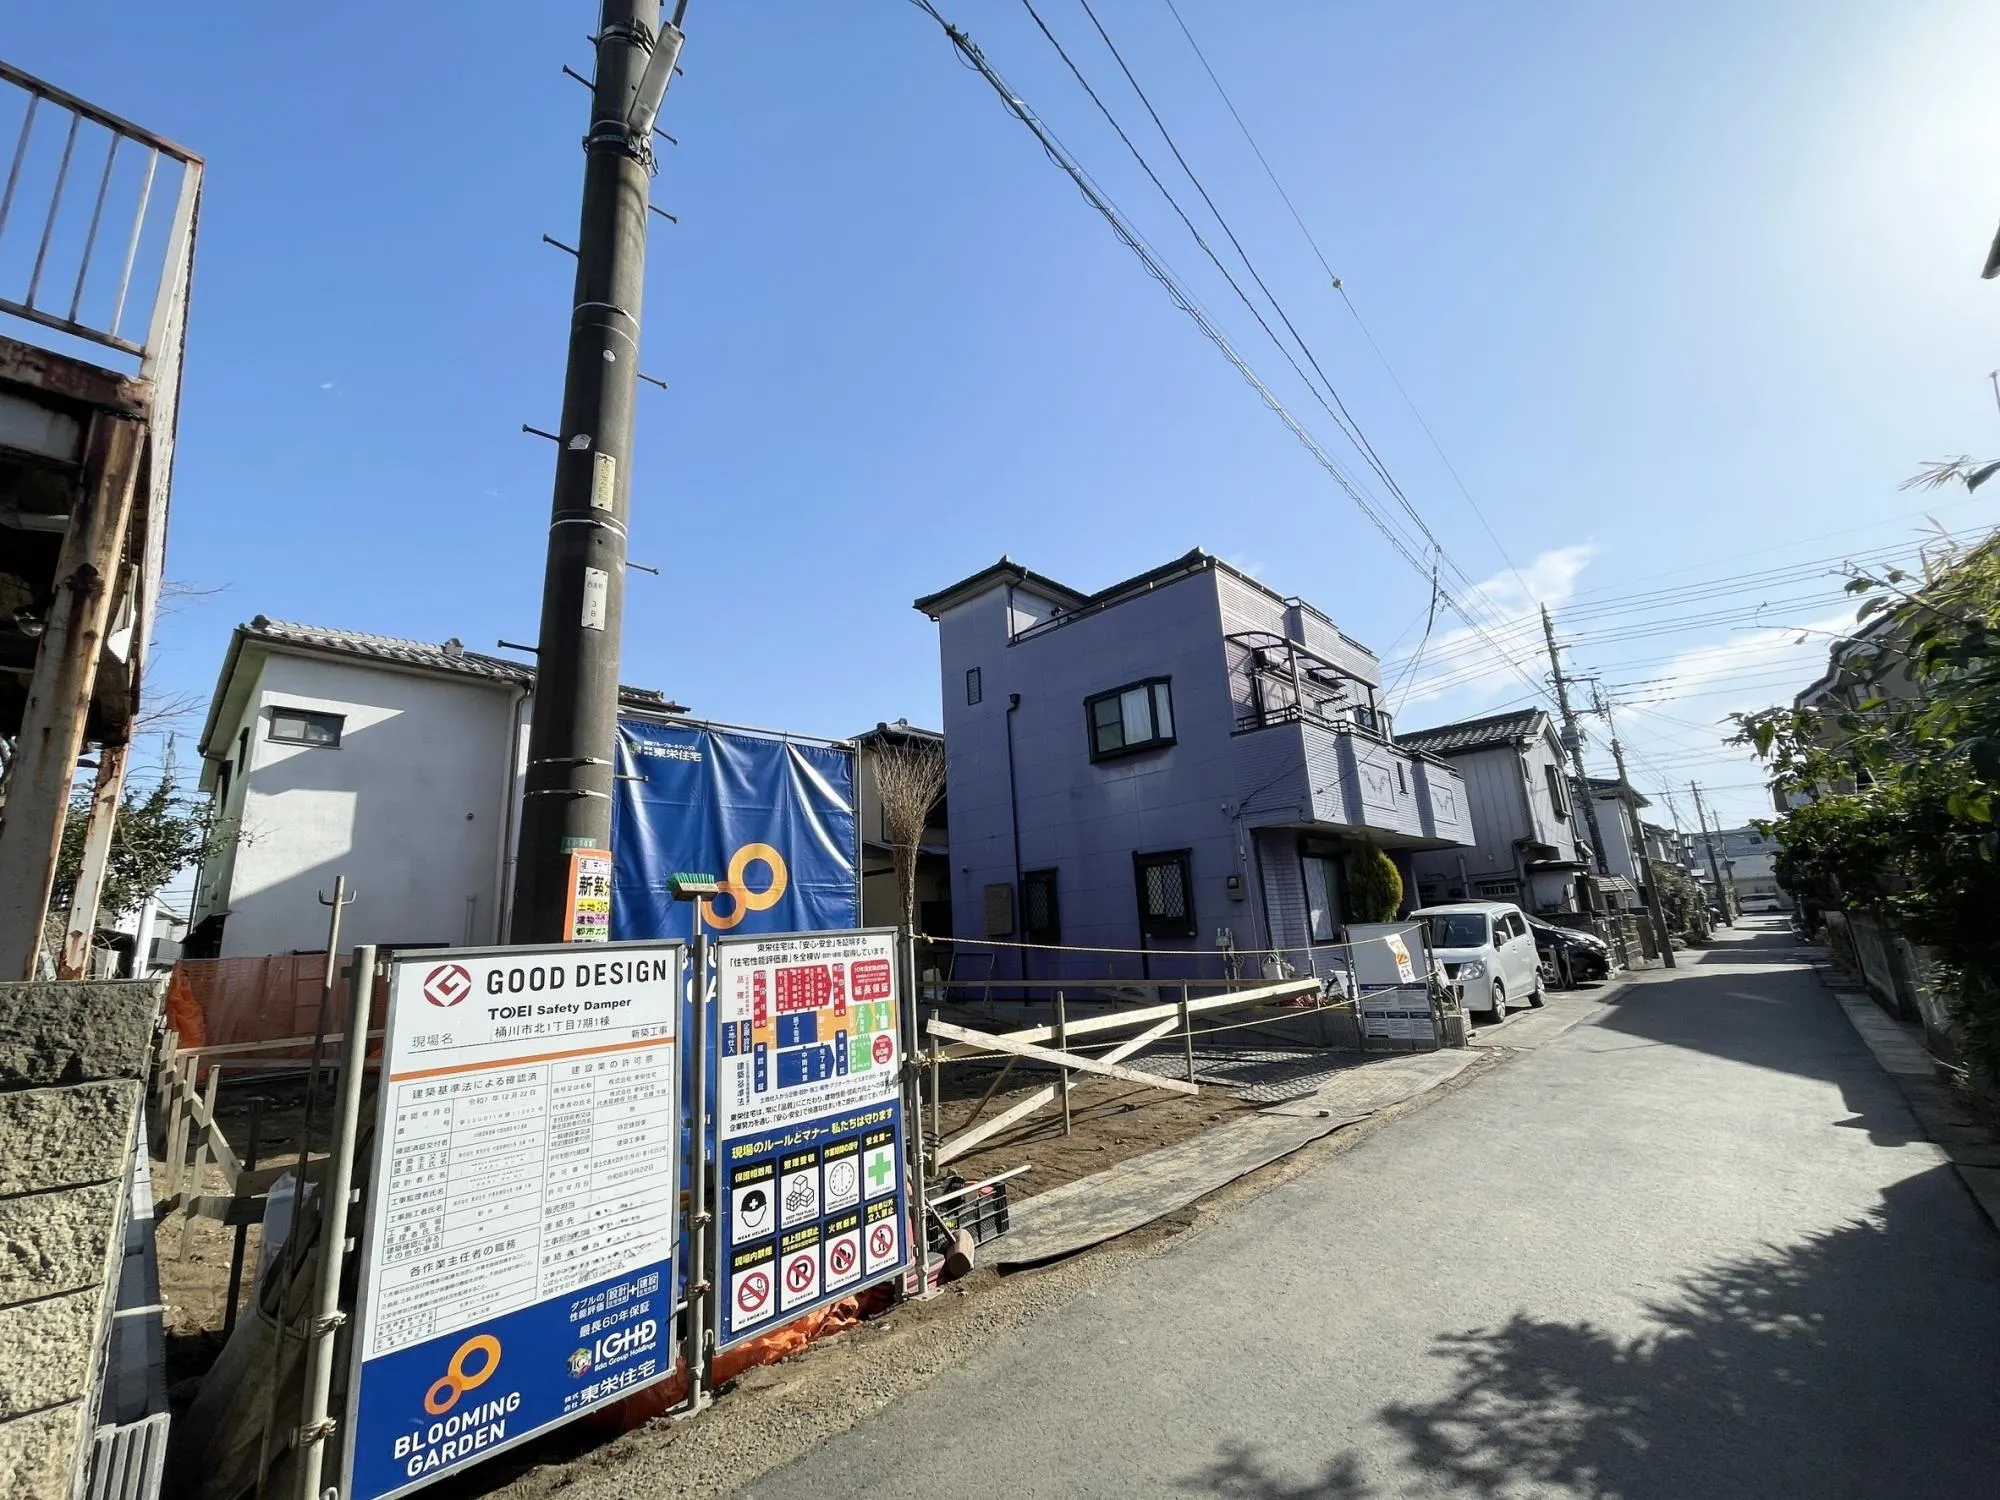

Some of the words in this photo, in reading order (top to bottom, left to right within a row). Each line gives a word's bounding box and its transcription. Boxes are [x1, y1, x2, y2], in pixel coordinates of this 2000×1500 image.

[653, 747, 702, 762] 東栄住宅
[487, 967, 565, 995] GOOD
[576, 960, 667, 987] DESIGN
[854, 983, 889, 996] 延長保証
[537, 1003, 580, 1016] Safety
[584, 998, 632, 1011] Damper
[494, 1016, 611, 1038] 桶川市北1丁目7期1棟
[631, 1026, 668, 1038] 新築工事
[411, 1034, 453, 1048] 現場名
[728, 1025, 736, 1054] 土地仕入
[412, 1072, 537, 1099] 建築基準法による確認済
[608, 1076, 632, 1085] 株式会社
[732, 1129, 830, 1160] 現場のルールとマナー
[831, 1107, 893, 1135] 私たちは守ります
[866, 1132, 892, 1146] 安全第一
[545, 1200, 576, 1215] 販売担当
[868, 1207, 895, 1223] 立入禁止
[737, 1232, 750, 1241] WEAR
[752, 1228, 770, 1237] HELMET
[386, 1243, 440, 1261] その他の事項
[410, 1239, 517, 1278] 各作業主任者の職務
[734, 1245, 773, 1268] 現場内禁煙
[639, 1275, 657, 1289] 建設
[833, 1277, 844, 1286] OPEN
[571, 1293, 605, 1312] ダブルの
[608, 1286, 629, 1301] 設計
[795, 1291, 814, 1302] PARKING
[570, 1302, 606, 1322] 性能評価
[579, 1300, 651, 1339] 最長60年保証
[738, 1317, 746, 1325] NO
[746, 1309, 768, 1322] SMOKING
[594, 1319, 657, 1364] IGHD
[608, 1350, 629, 1366] Group
[629, 1341, 657, 1357] Holdings
[580, 1358, 656, 1406] 東栄住宅
[564, 1391, 580, 1404] 株式
[563, 1401, 579, 1413] 会社
[394, 1391, 521, 1460] BLOOMING
[407, 1420, 506, 1477] GARDEN
